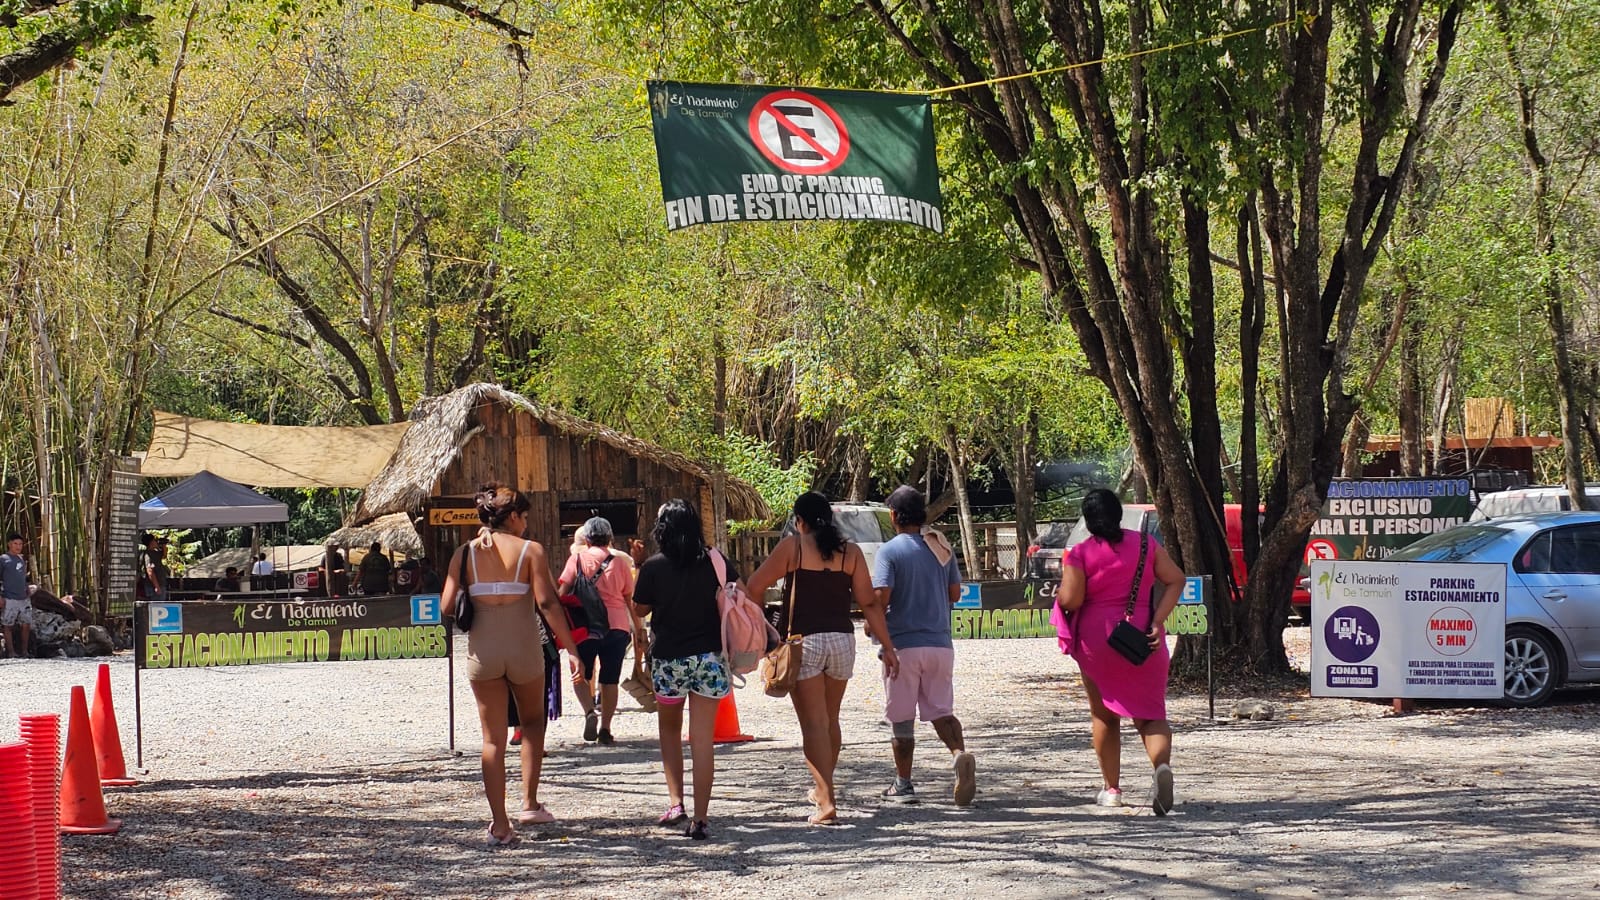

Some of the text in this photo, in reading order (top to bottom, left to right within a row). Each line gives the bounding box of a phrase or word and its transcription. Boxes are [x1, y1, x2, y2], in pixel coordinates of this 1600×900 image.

[670, 93, 739, 109] El Nacimiento
[681, 107, 695, 117] De
[742, 174, 885, 194] END OF PARKING
[665, 192, 943, 233] FIN DE ESTACIONAMIENTO
[1327, 479, 1470, 498] ACIONAMIENTO
[1329, 498, 1432, 516] EXCLUSIVO
[1310, 518, 1345, 535] ARA
[1349, 518, 1369, 535] EL
[1335, 571, 1400, 586] El Nacimiento
[1430, 578, 1475, 590] PARKING
[1039, 581, 1058, 598] El
[1183, 581, 1196, 600] E
[1343, 587, 1356, 597] De
[1405, 590, 1500, 603] ESTACIONAMIENTO
[151, 606, 169, 627] P
[251, 601, 368, 620] El Nacimiento
[418, 599, 433, 620] E
[288, 618, 301, 627] De
[951, 608, 1058, 639] ESTACIONAM
[1430, 619, 1473, 632] MAXIMO
[146, 624, 447, 669] ESTACIONAMIENTO AUTOBUSES
[1436, 634, 1466, 646] 5 MIN
[1330, 666, 1374, 675] ZONA DE
